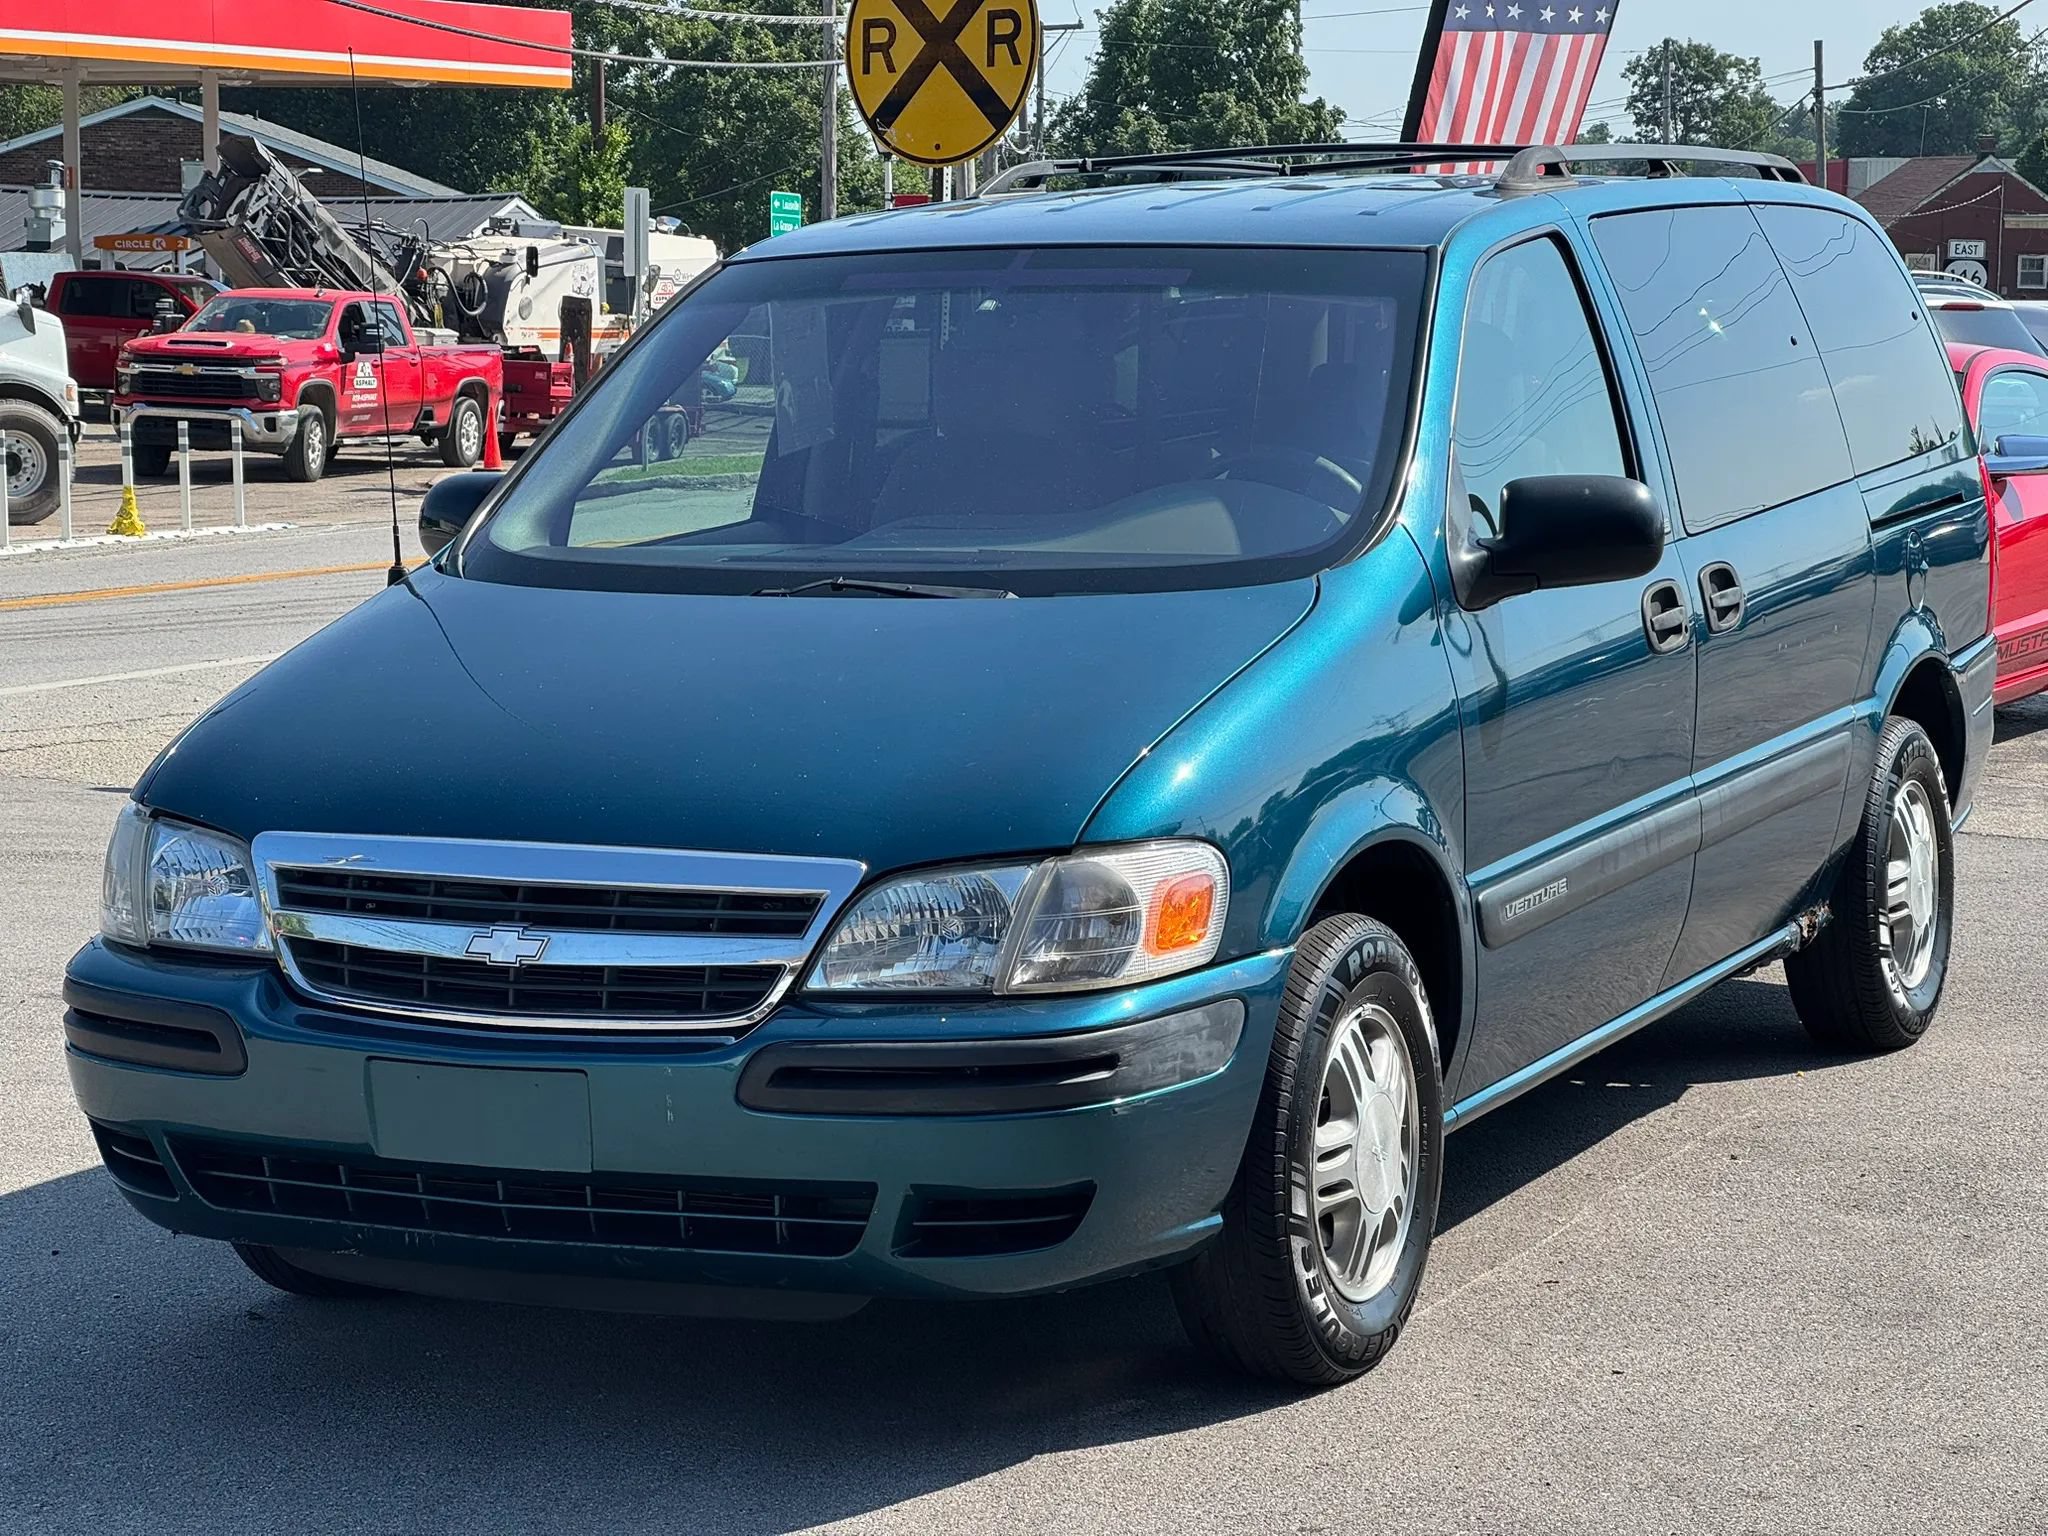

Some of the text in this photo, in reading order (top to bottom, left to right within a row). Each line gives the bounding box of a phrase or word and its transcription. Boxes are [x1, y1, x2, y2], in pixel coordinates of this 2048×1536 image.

[862, 17, 897, 75] R
[986, 8, 1022, 68] R
[114, 240, 150, 249] CIRCLE
[177, 240, 184, 248] 2
[1954, 243, 1979, 255] EAST
[1504, 877, 1569, 920] VENTURE
[1300, 1242, 1399, 1361] HERCULES
